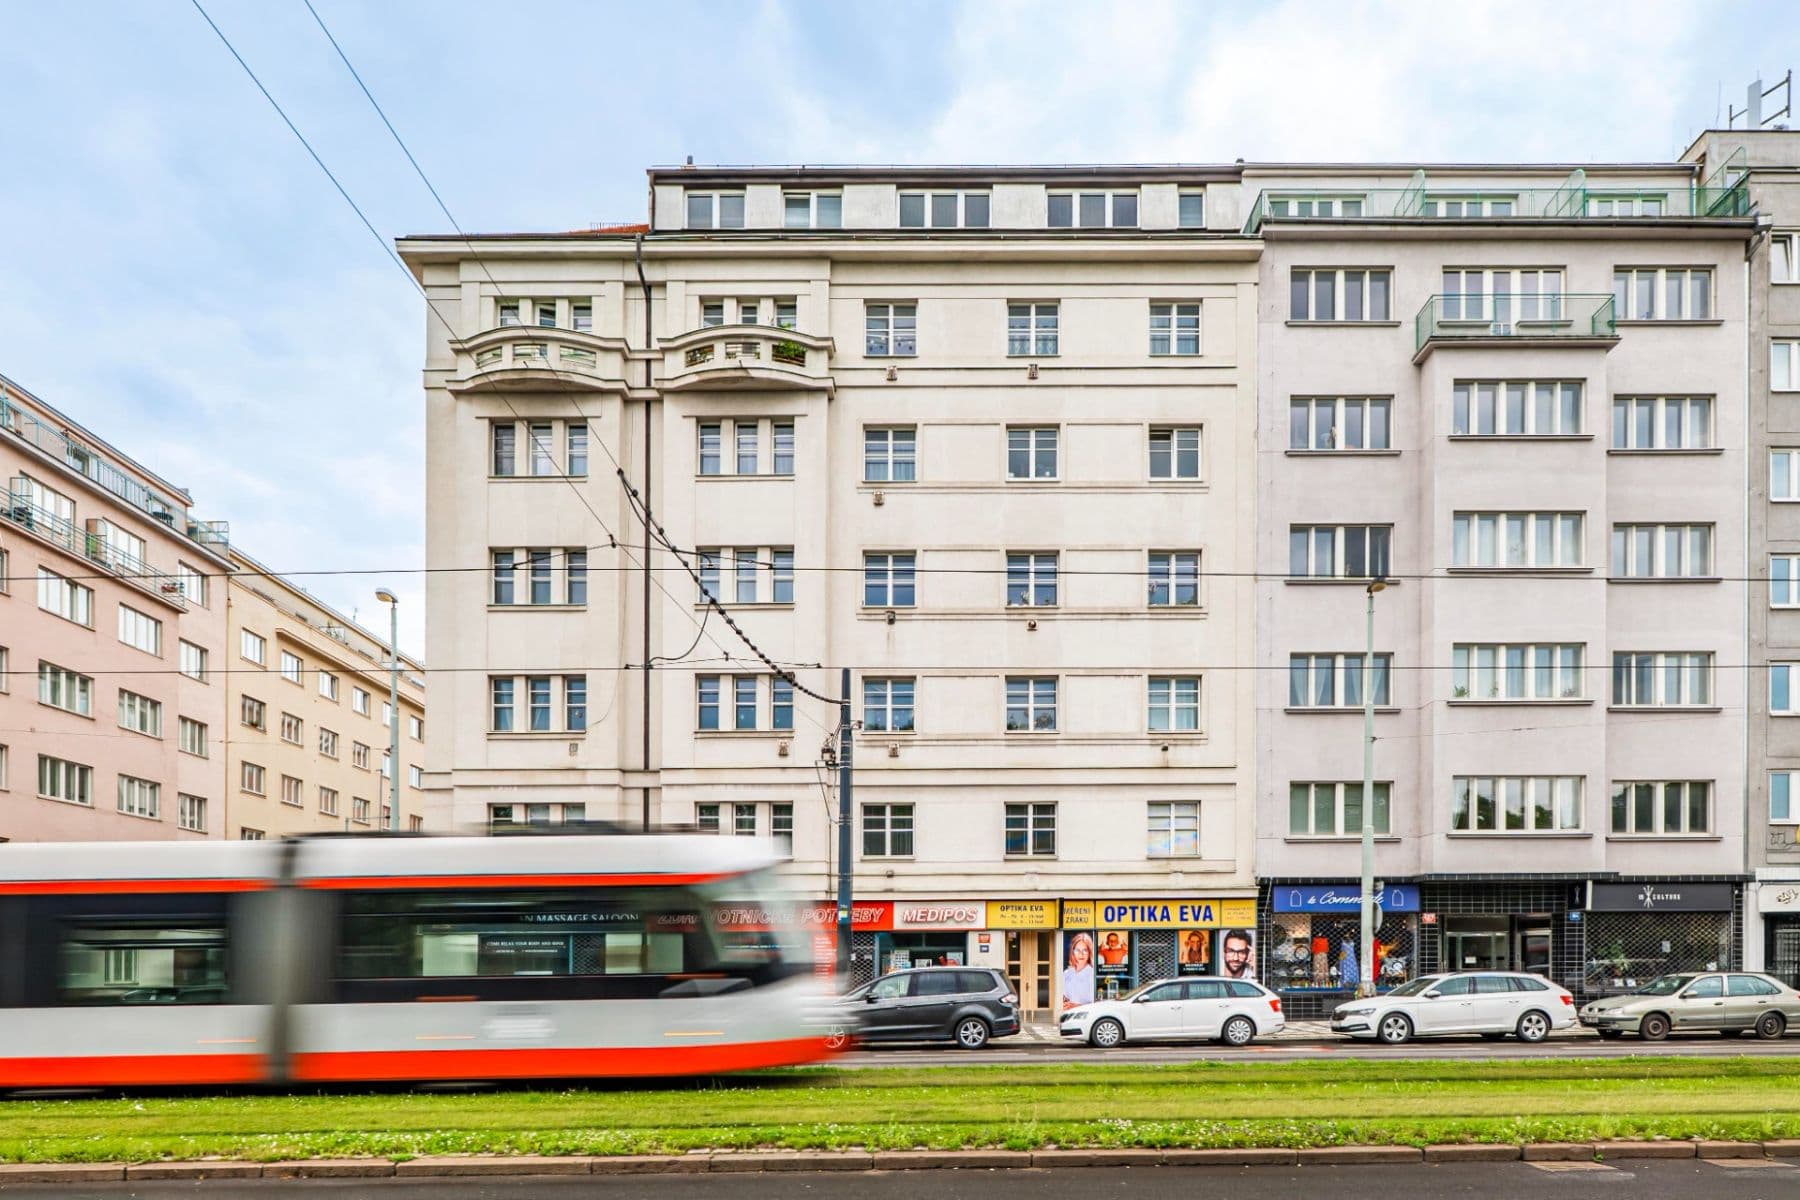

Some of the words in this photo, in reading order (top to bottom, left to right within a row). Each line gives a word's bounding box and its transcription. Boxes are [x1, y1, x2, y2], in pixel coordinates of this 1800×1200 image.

[1320, 891, 1384, 905] Commde
[800, 907, 884, 924] POTEBY
[902, 907, 978, 924] MEDIPOS
[1104, 905, 1171, 923] OPTIKA
[1179, 905, 1214, 922] EVA
